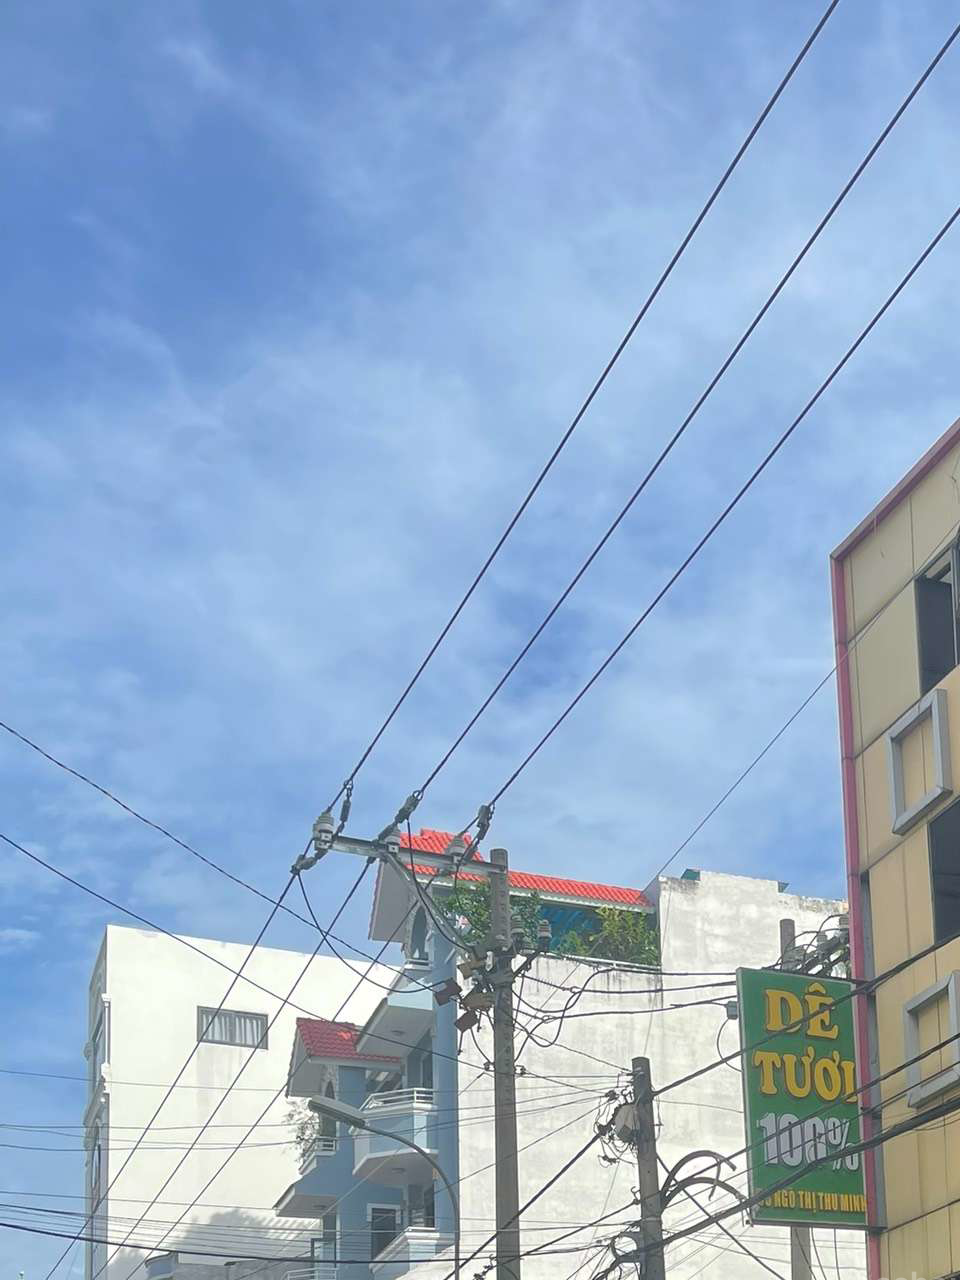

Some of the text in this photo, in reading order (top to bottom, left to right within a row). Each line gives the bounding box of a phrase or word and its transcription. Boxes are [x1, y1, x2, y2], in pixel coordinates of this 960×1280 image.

[764, 982, 839, 1040] DÊ
[753, 1046, 858, 1103] TƯƠI
[758, 1112, 859, 1171] 100%
